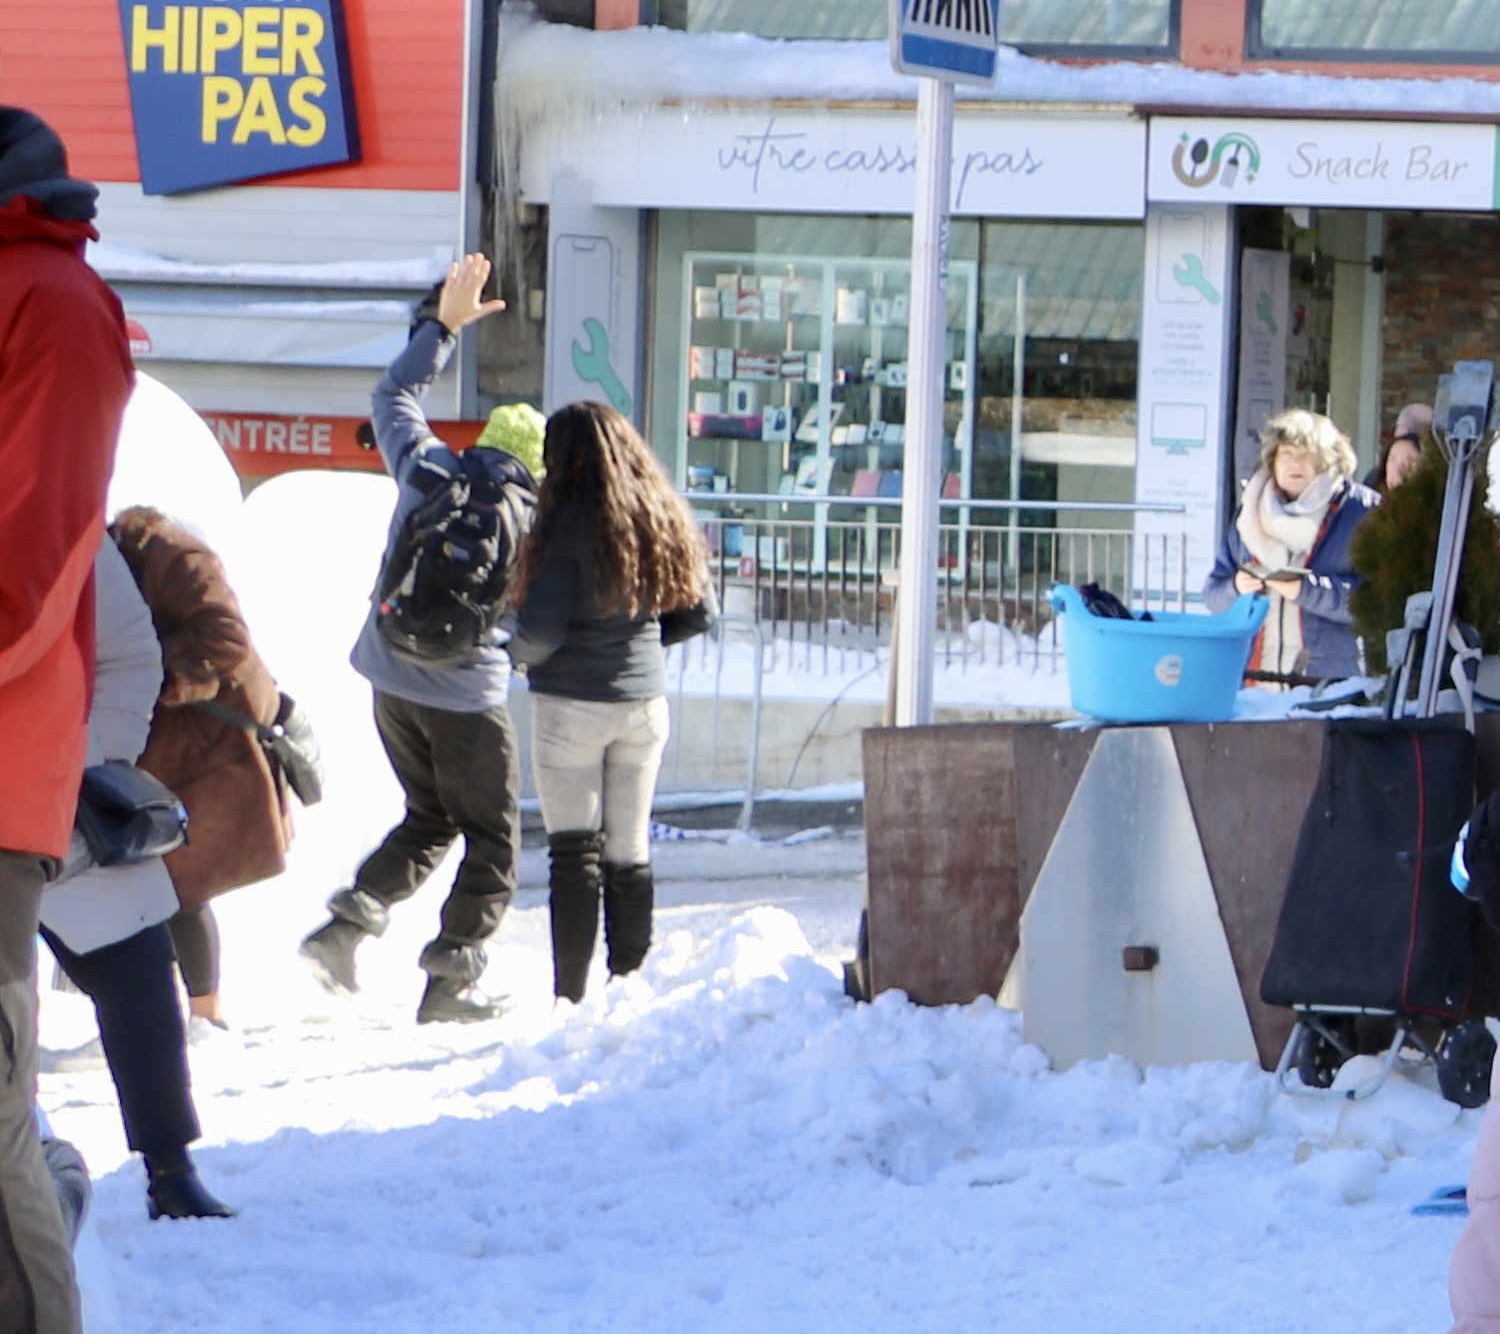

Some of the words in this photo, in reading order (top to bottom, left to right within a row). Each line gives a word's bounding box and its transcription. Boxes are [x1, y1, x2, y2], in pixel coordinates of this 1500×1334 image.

[131, 4, 325, 77] HIPER
[201, 75, 328, 148] PAS
[955, 147, 1044, 210] pas
[1288, 142, 1388, 182] Snack
[1407, 142, 1469, 183] Bar
